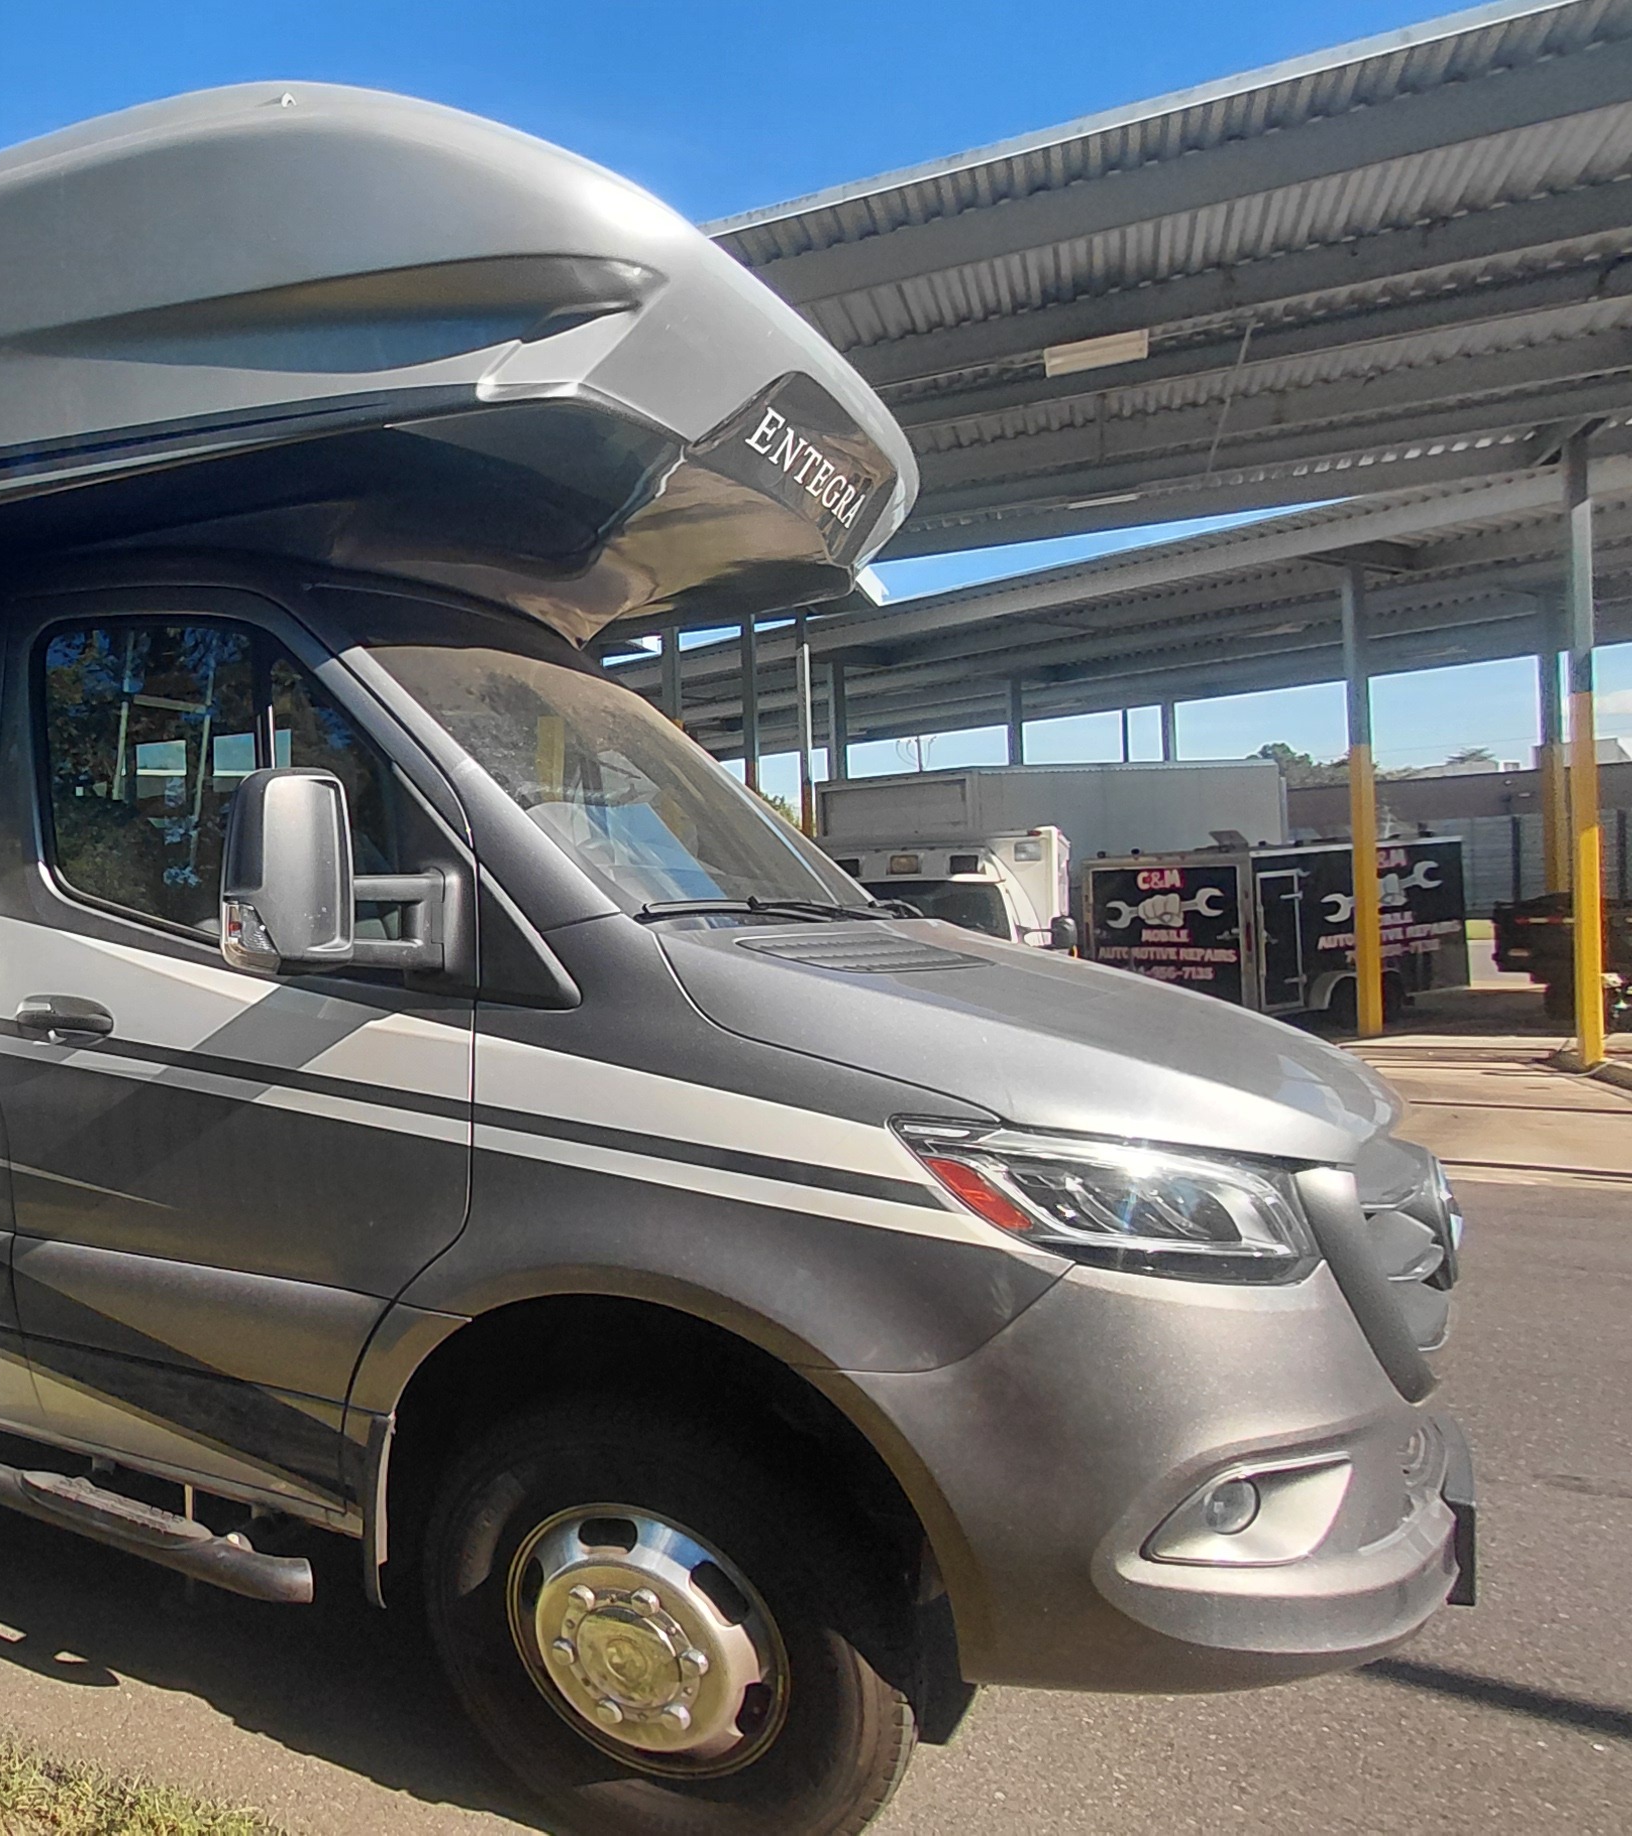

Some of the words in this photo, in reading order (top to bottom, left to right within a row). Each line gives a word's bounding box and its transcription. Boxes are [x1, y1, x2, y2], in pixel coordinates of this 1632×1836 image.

[745, 408, 866, 528] ENTEGRA
[1376, 848, 1408, 869] &M
[1136, 868, 1182, 890] C&M
[1141, 928, 1190, 943] MOBILE
[1179, 947, 1238, 963] REPAIRS
